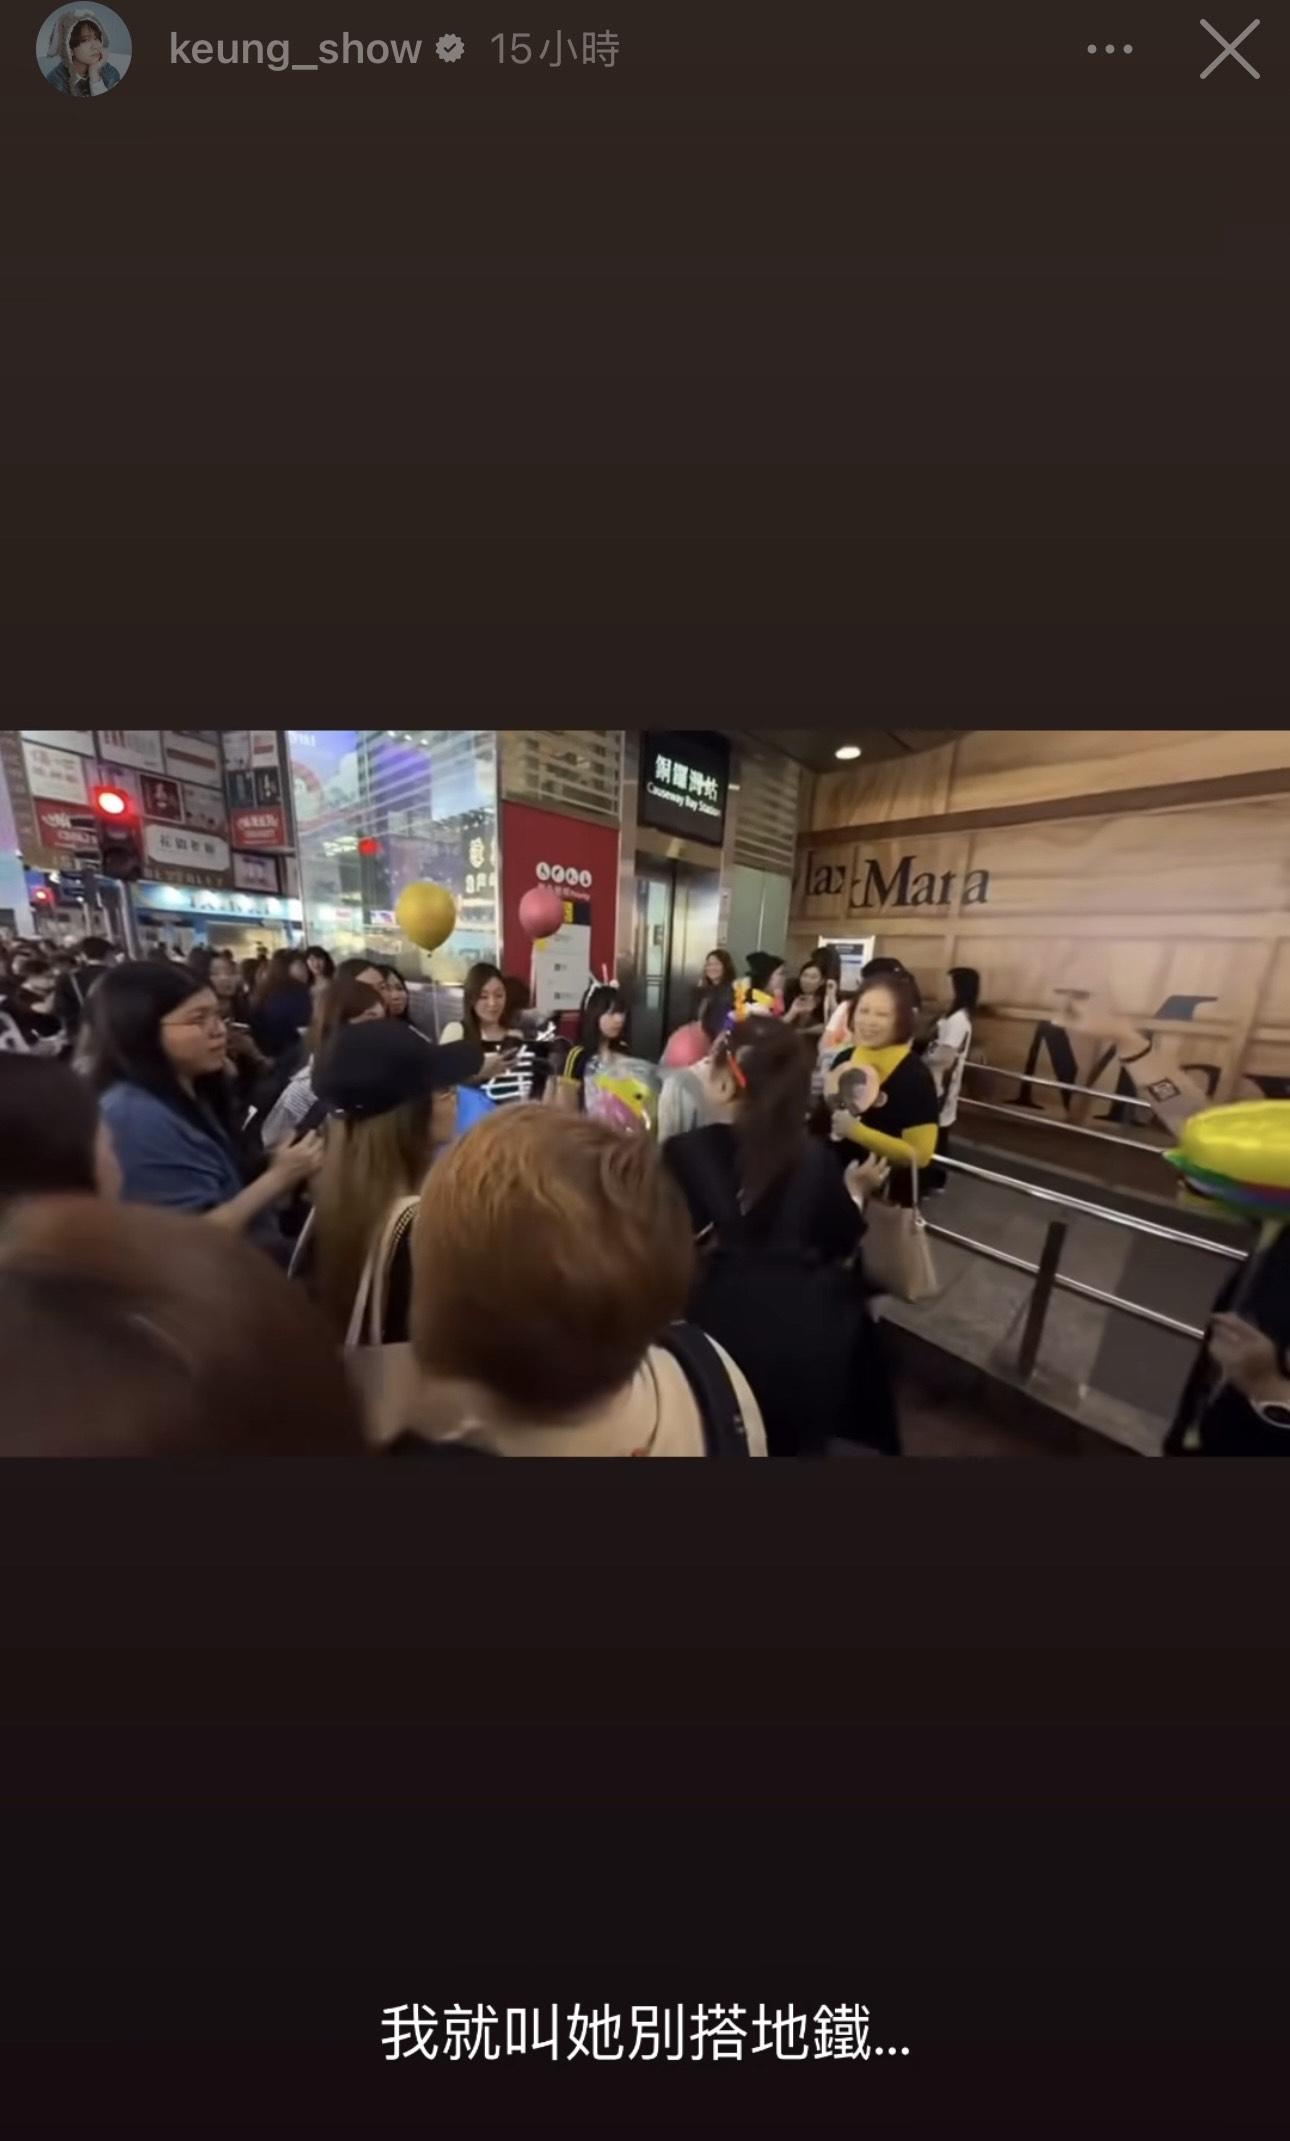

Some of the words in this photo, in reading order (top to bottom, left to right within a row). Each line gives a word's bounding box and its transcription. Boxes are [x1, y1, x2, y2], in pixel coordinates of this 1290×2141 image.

[655, 754, 718, 801] 銅鑼灣站
[646, 781, 684, 807] Causeway
[685, 795, 699, 812] Bay
[699, 800, 722, 816] Station
